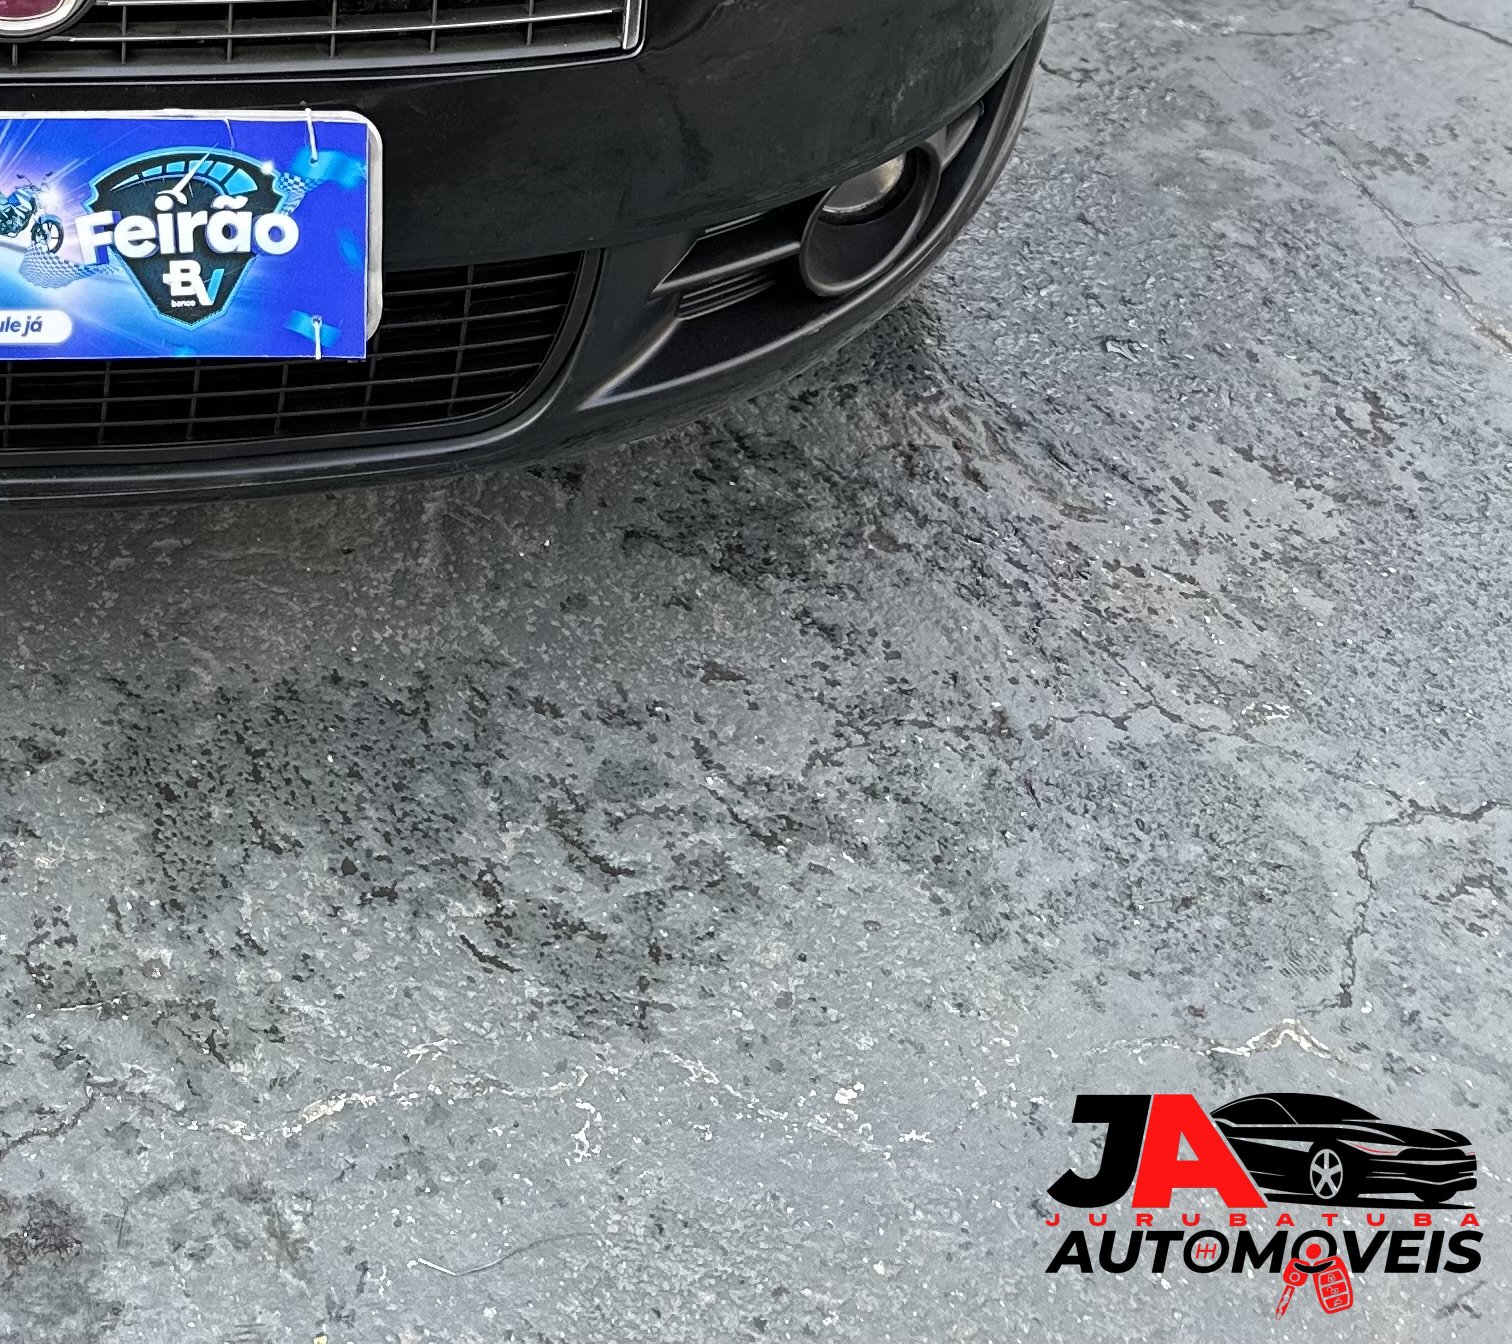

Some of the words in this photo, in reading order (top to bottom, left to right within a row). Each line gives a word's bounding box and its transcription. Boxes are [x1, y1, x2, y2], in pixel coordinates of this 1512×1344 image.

[75, 195, 299, 264] Feirão
[162, 259, 225, 305] BV
[21, 315, 43, 337] já
